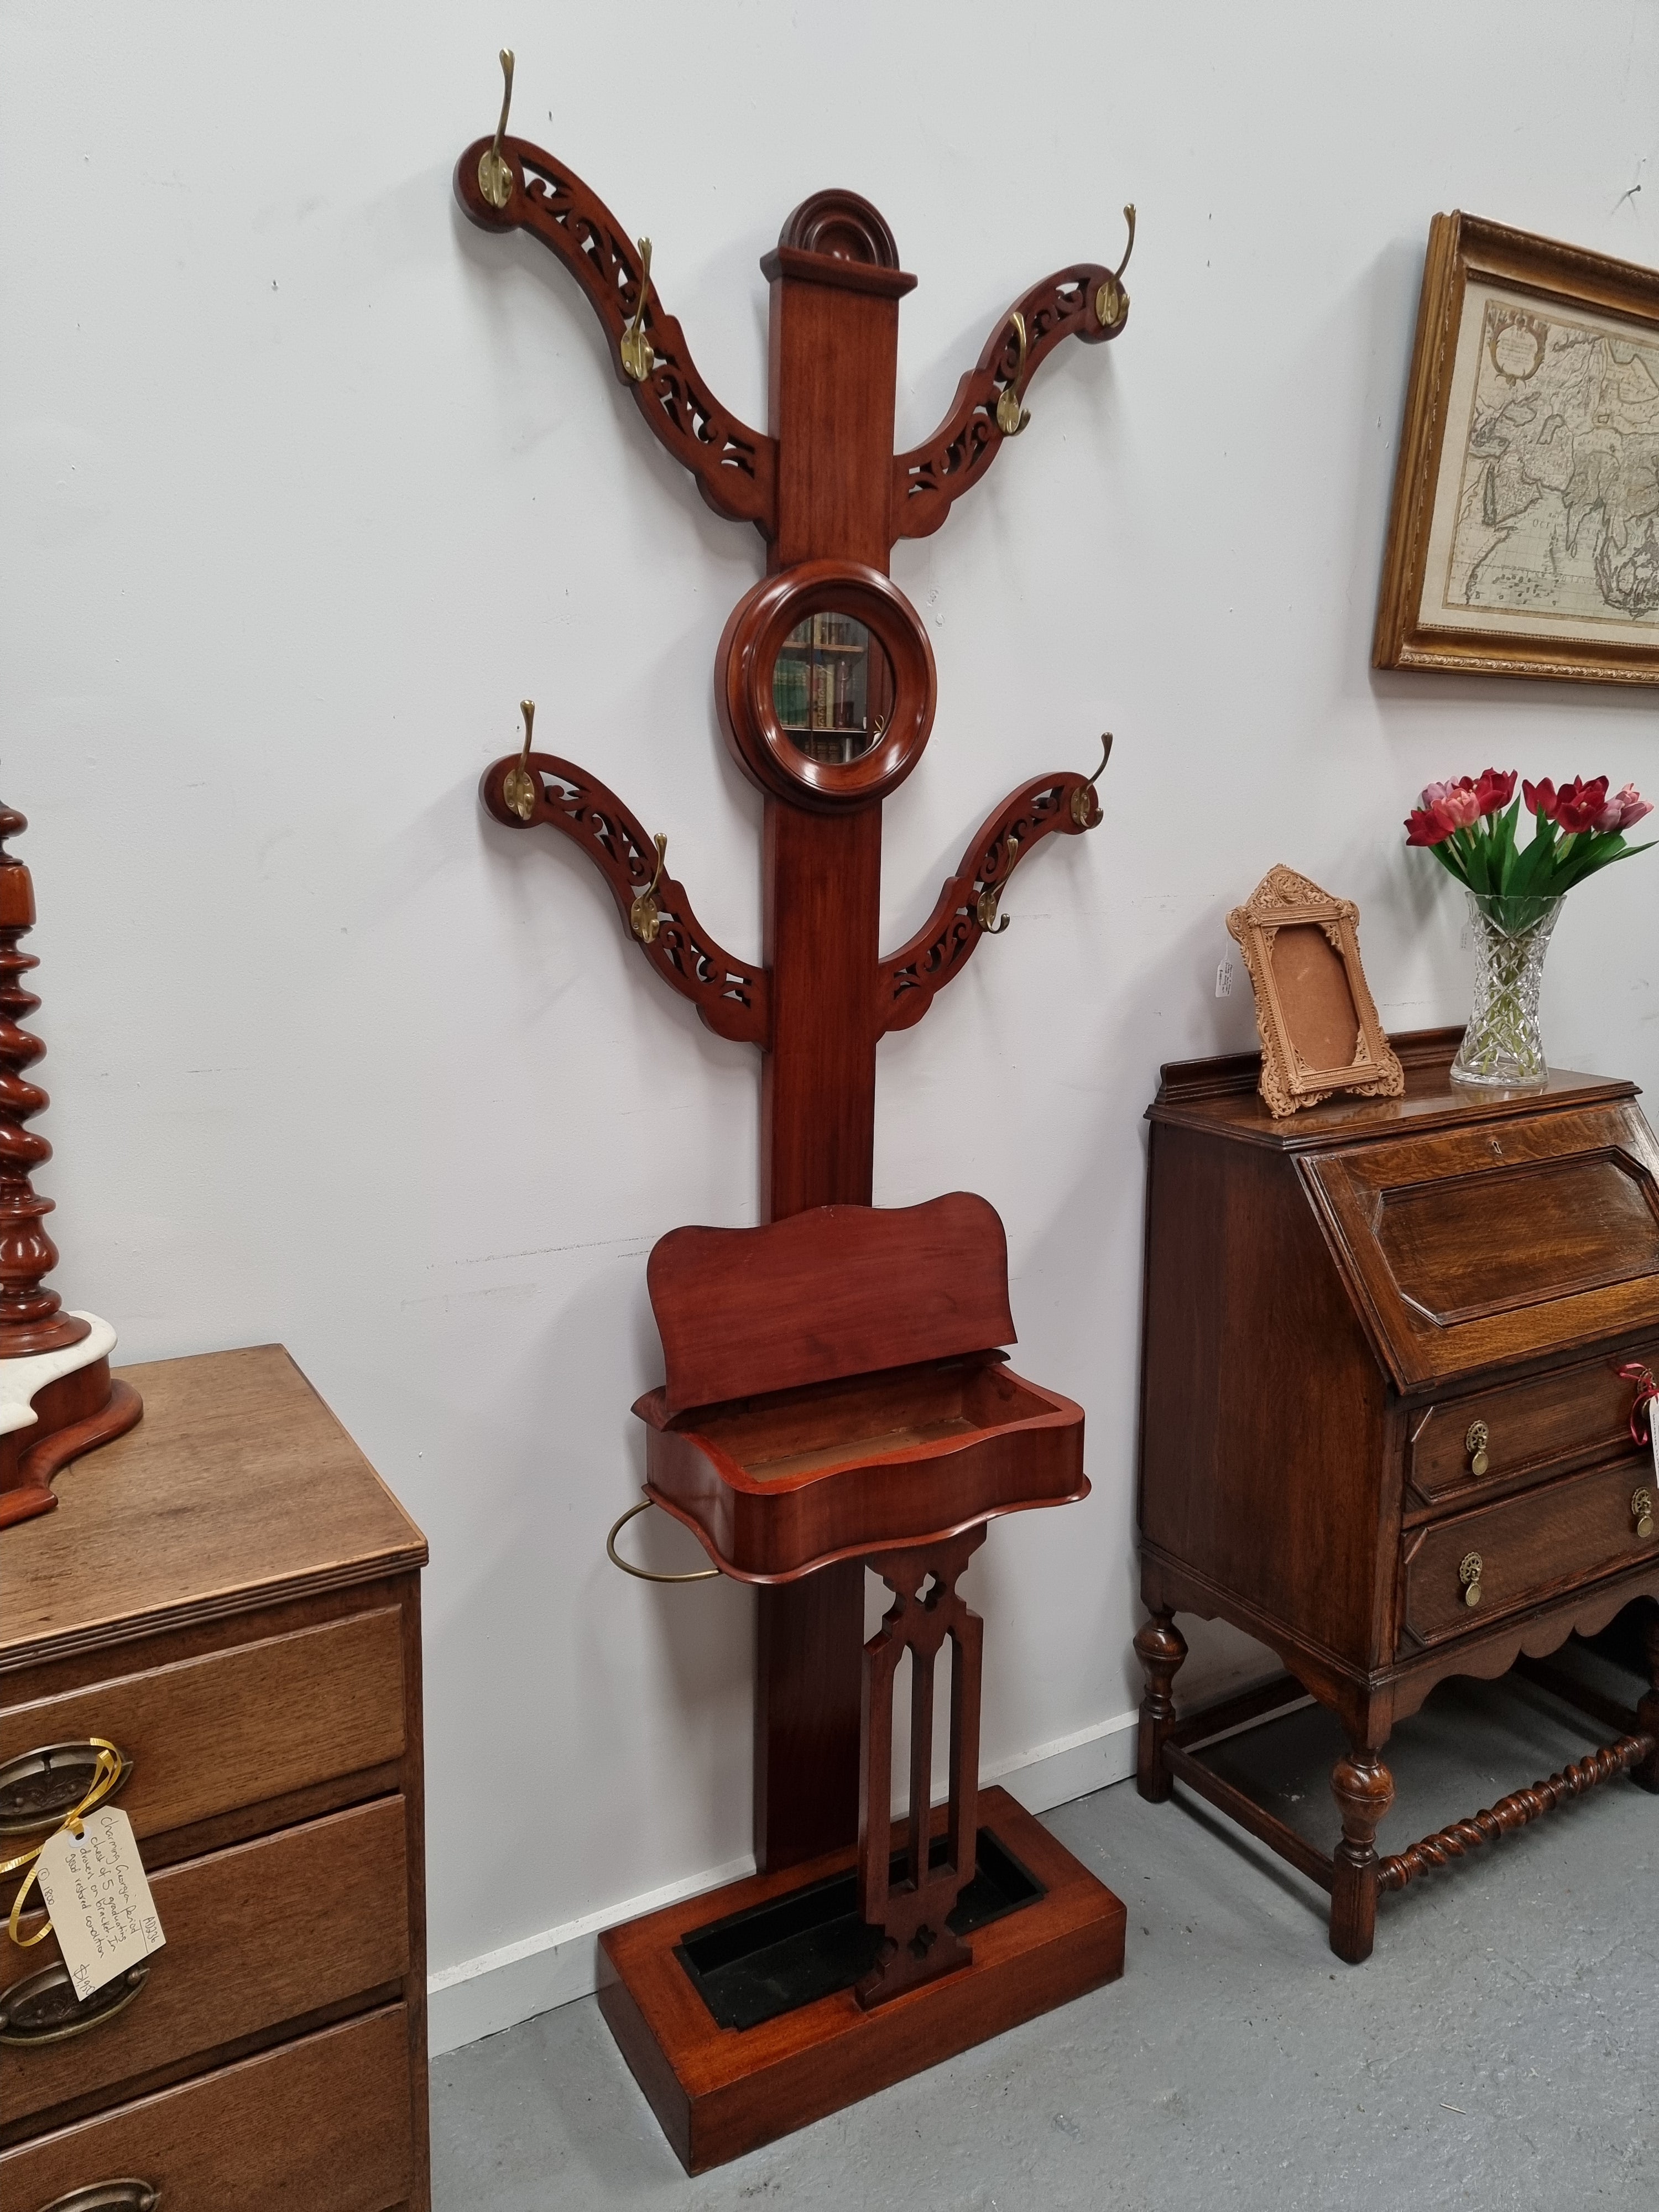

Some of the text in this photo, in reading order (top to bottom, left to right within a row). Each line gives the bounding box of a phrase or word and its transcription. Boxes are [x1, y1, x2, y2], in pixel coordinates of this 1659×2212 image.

[91, 1837, 103, 1863] chest
[100, 1867, 111, 1877] of
[43, 1886, 55, 1905] 1800
[91, 1885, 98, 1897] on
[103, 1879, 114, 1890] 5
[65, 1854, 104, 1959] good restored condition
[124, 1905, 140, 1934] Period
[143, 1916, 160, 1944] AD236
